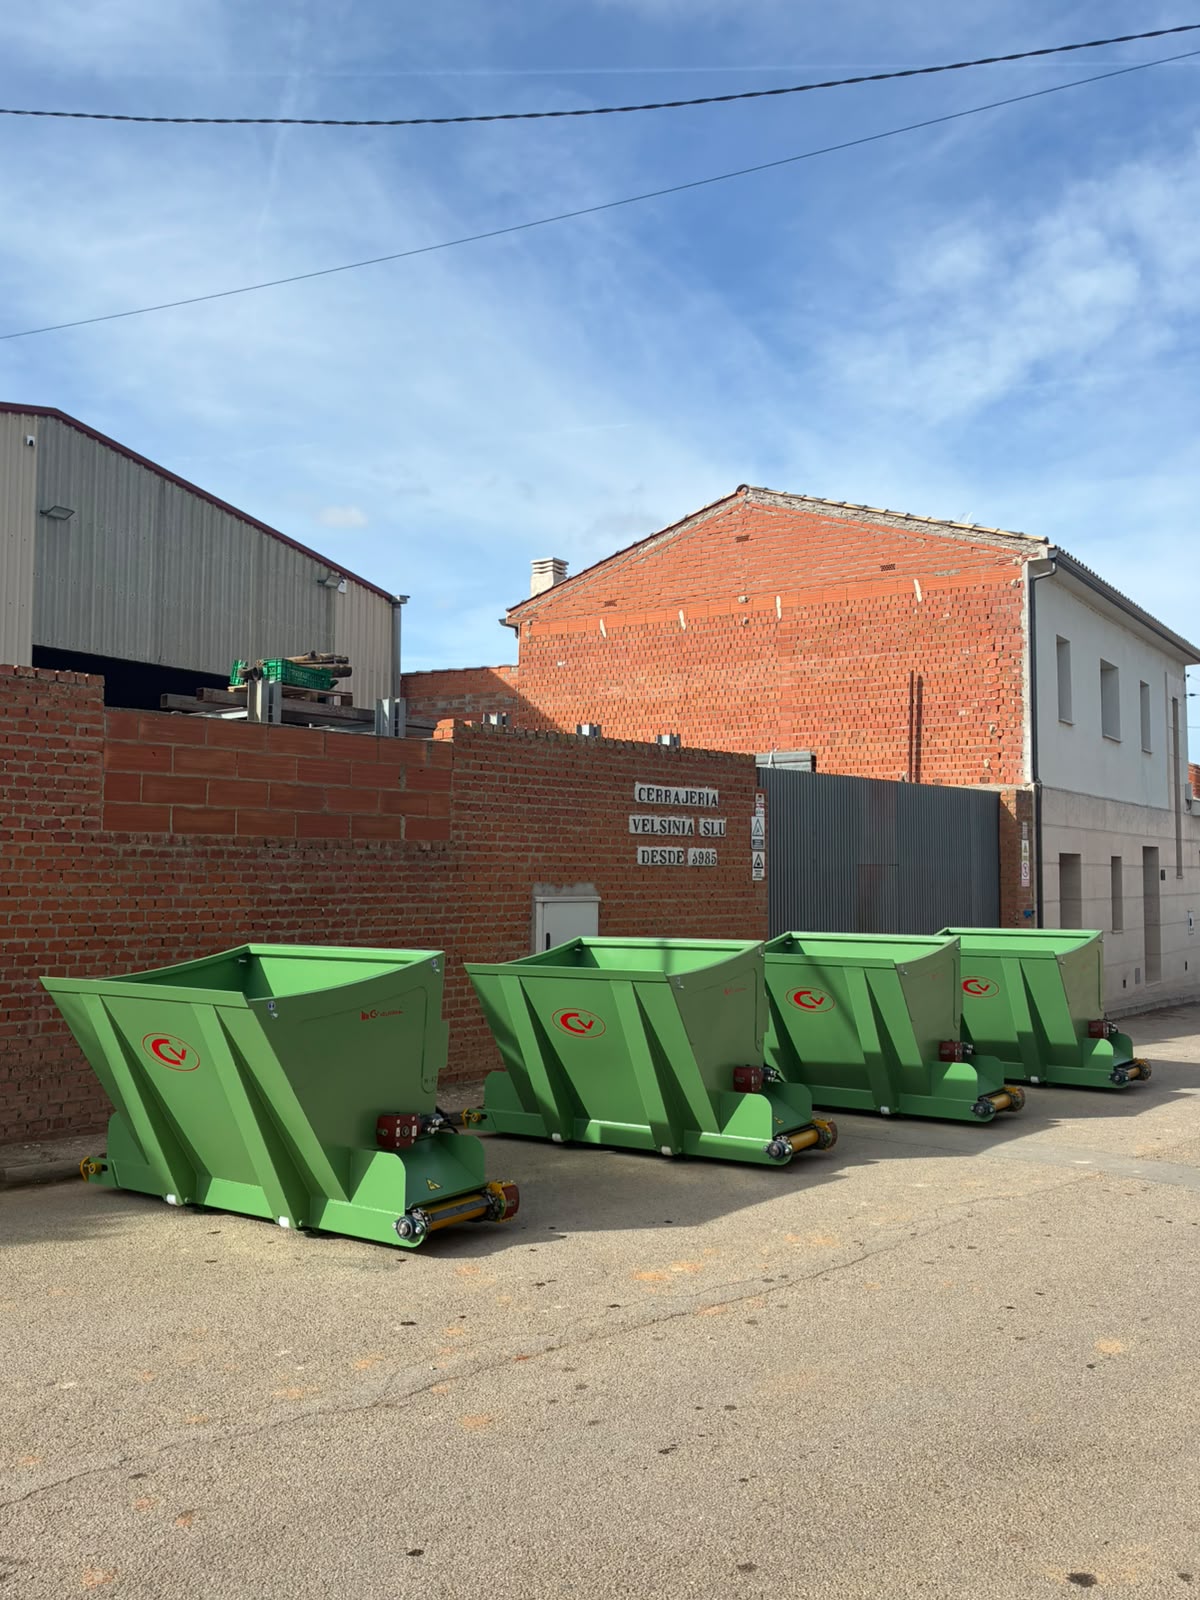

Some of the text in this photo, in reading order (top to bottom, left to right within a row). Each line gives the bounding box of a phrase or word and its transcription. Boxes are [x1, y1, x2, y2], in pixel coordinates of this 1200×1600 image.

[639, 787, 717, 806] CERRAJERIA
[633, 818, 726, 836] VELSINIA SLU
[641, 850, 684, 864] DESDE
